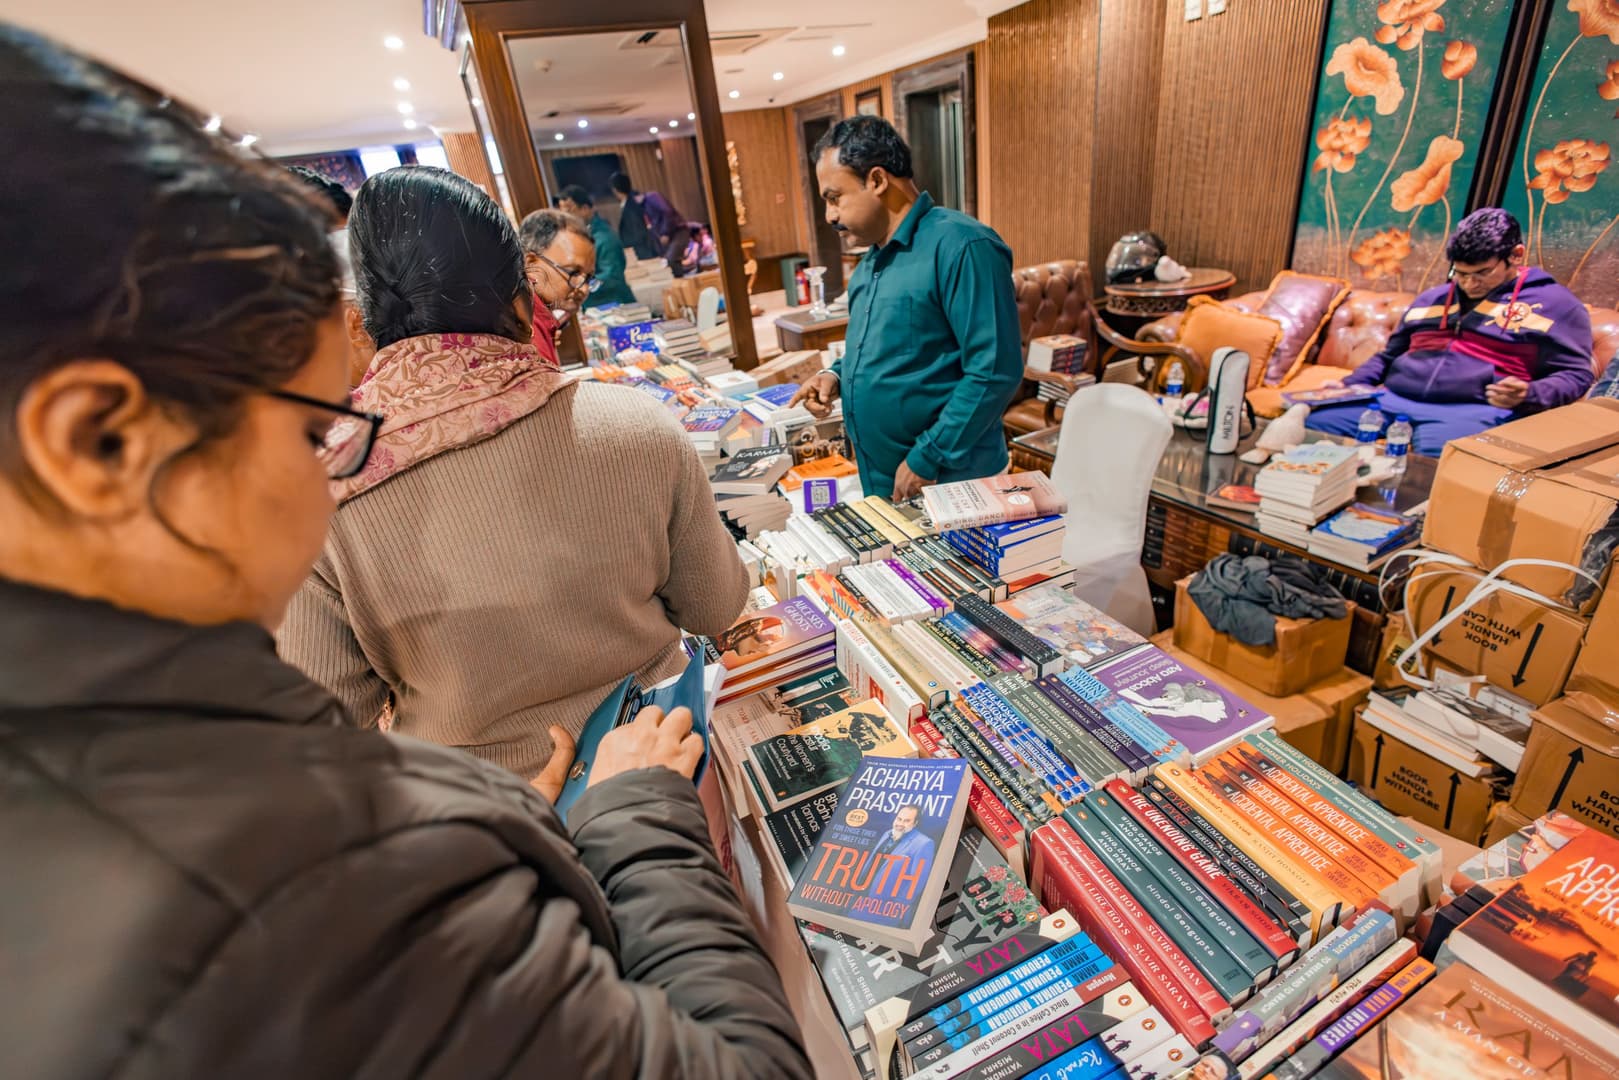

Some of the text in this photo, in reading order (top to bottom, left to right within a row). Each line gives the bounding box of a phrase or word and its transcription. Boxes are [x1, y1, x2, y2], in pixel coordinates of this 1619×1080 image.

[1222, 405, 1235, 440] MILTON
[736, 448, 780, 459] KARMA
[784, 606, 813, 632] GHOSTS
[792, 600, 828, 630] ALICE SEES
[1463, 609, 1521, 640] WITH CAR
[1461, 618, 1509, 646] HANDLE
[1464, 631, 1498, 652] BOOK
[1013, 673, 1032, 689] Mahi
[1063, 677, 1094, 701] MOHINI
[1077, 669, 1108, 694] MOHINI
[1128, 673, 1162, 692] Abbas
[974, 690, 989, 704] THE
[987, 702, 1016, 731] MOSAIC
[982, 687, 998, 702] THE
[996, 699, 1025, 726] MOSAIC
[994, 680, 1012, 695] Mahi
[1013, 698, 1031, 713] ANAND
[1003, 675, 1073, 740] Mahi ANAND NEELAKANTAN
[966, 695, 981, 709] THE
[980, 707, 1007, 735] MOSAIC
[776, 738, 799, 767] Courtyard
[794, 742, 816, 773] Women's
[915, 731, 937, 754] AMETHI
[951, 712, 970, 732] HELLO,
[968, 731, 993, 757] BASTAR
[992, 758, 1012, 778] RAHUL
[1010, 777, 1036, 804] PANDITA
[1256, 742, 1287, 765] SUMMER
[1286, 761, 1323, 790] HOLIDAYS
[1302, 757, 1341, 787] HOLIDAYS
[857, 766, 945, 793] ACHARYA
[976, 760, 1003, 788] BASTAR
[1392, 770, 1434, 798] HANDLE
[1400, 765, 1428, 786] BOOK
[845, 787, 953, 818] PRASHANT
[990, 799, 1008, 818] VIJAY
[1001, 785, 1026, 812] HELLO,
[1263, 767, 1370, 843] ACCIDENTAL APPRENTICE
[1384, 775, 1440, 812] WITH CARE
[800, 803, 820, 833] Tamas
[850, 813, 865, 821] BEST
[985, 814, 1004, 834] VIJAY
[1243, 778, 1349, 857] ACCIDENTAL APPRENTICE
[1571, 800, 1611, 829] WITH
[844, 825, 861, 836] THOSE
[1117, 822, 1153, 857] AND PRAY
[1120, 815, 1163, 857] SING, DANCE
[1128, 793, 1151, 812] THE
[1144, 810, 1195, 853] UNENDING
[1189, 848, 1223, 880] GAME
[1166, 790, 1269, 881] PYRE PERUMAL MURUGAN
[1227, 791, 1333, 873] ACCIDENTAL APPRENTICE
[1097, 838, 1132, 872] AND PRAY
[1100, 830, 1142, 873] SING, DANCE
[1162, 803, 1190, 827] PYRE
[1190, 829, 1225, 860] PERUMAL
[1223, 858, 1267, 897] MURUGAN
[812, 842, 925, 900] TRUTH
[800, 883, 910, 920] WITHOUT APOLOGY
[936, 877, 992, 951] ITY
[963, 875, 1019, 936] OUR
[1167, 867, 1196, 896] Hindol
[1194, 893, 1237, 938] Sengupta
[1102, 873, 1122, 894] LIKE
[1119, 894, 1144, 918] BOYS
[1146, 924, 1173, 954] SUVIR
[1170, 951, 1203, 987] SARAN
[1146, 884, 1216, 958] Hindol Sengupta
[965, 936, 1028, 977] LATA
[1050, 940, 1078, 959] AMMA
[1061, 951, 1089, 971] AMMA
[1088, 886, 1109, 907] LIKE
[1106, 910, 1131, 936] BOYS
[1132, 942, 1160, 977] SUVIR
[1157, 974, 1191, 1011] SARAN
[927, 971, 957, 990] MISHRA
[1010, 953, 1052, 981] PERUMAL
[1021, 965, 1063, 993] PERUMAL
[1072, 963, 1100, 984] AMMA
[1085, 971, 1117, 992] Murugan
[856, 975, 877, 1006] SHREE
[928, 976, 966, 999] YATINDRA
[967, 975, 1012, 1004] MURUGAN
[977, 986, 1023, 1017] MURUGAN
[1031, 977, 1074, 1006] PERUMAL
[986, 999, 1033, 1031] MURUGAN
[1029, 1007, 1052, 1024] Coffee
[1053, 998, 1070, 1012] Black
[991, 1024, 1018, 1045] Coconut
[1021, 1014, 1090, 1062] LATA
[1320, 1008, 1370, 1047] INSPIRES
[972, 1039, 990, 1057] Shell
[1453, 1019, 1501, 1056] MAN
[1505, 1054, 1538, 1077] OF
[980, 1054, 1013, 1076] MISHRA
[1056, 1049, 1102, 1080] Karnali
